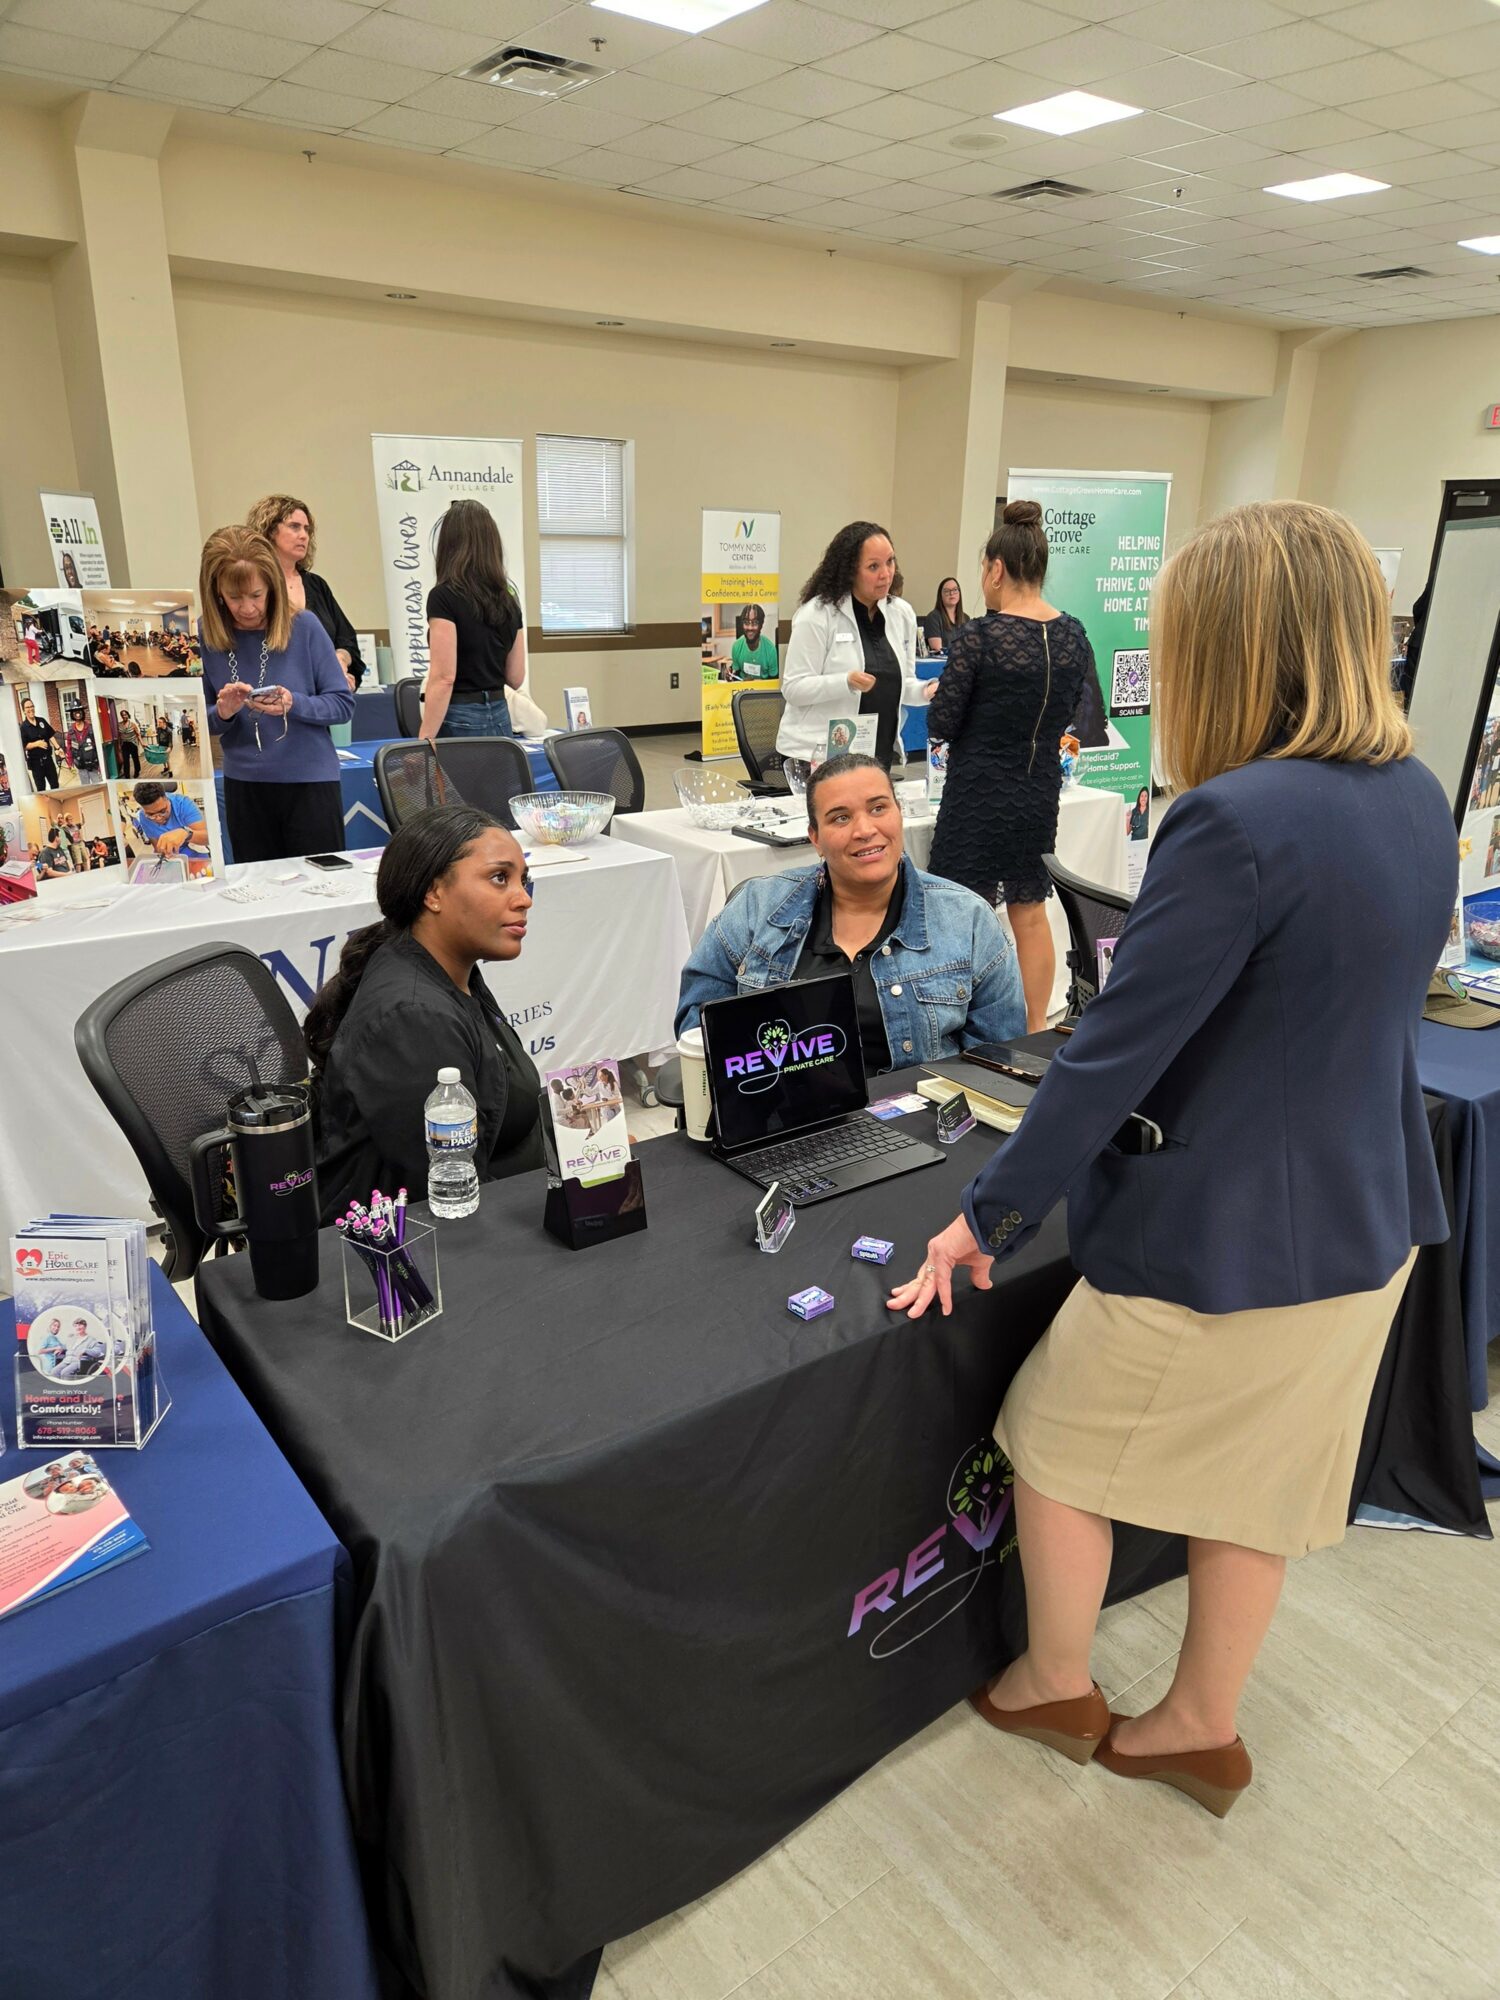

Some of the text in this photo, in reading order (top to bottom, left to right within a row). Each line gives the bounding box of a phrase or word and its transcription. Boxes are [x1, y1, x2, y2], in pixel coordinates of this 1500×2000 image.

[428, 465, 514, 484] Annandale
[1044, 508, 1096, 529] Cottage
[62, 518, 99, 545] All In
[1044, 526, 1082, 543] Grove
[393, 512, 420, 570] lives
[719, 542, 767, 553] TOMMY NOBIS
[1118, 535, 1160, 550] HELPING
[732, 553, 754, 561] CENTER
[1049, 546, 1091, 554] OME CARE
[1110, 556, 1159, 571] PATIENTS
[1095, 577, 1156, 593] THRIVE, ON
[1104, 597, 1147, 613] HOME AT
[404, 577, 430, 679] appiness
[1134, 617, 1150, 631] TIM
[1119, 707, 1143, 716] SCAN ME
[1110, 761, 1141, 771] Support.
[506, 1001, 553, 1028] RIES
[725, 1033, 835, 1078] REVIVE
[783, 1055, 834, 1074] PRIVATE CARE
[566, 1148, 621, 1169] REVIVE
[270, 1171, 312, 1190] REVIVE
[48, 1251, 69, 1260] Epic
[75, 1260, 99, 1269] CARE
[25, 1394, 104, 1404] Home and Live
[30, 1404, 101, 1415] Comfortably!
